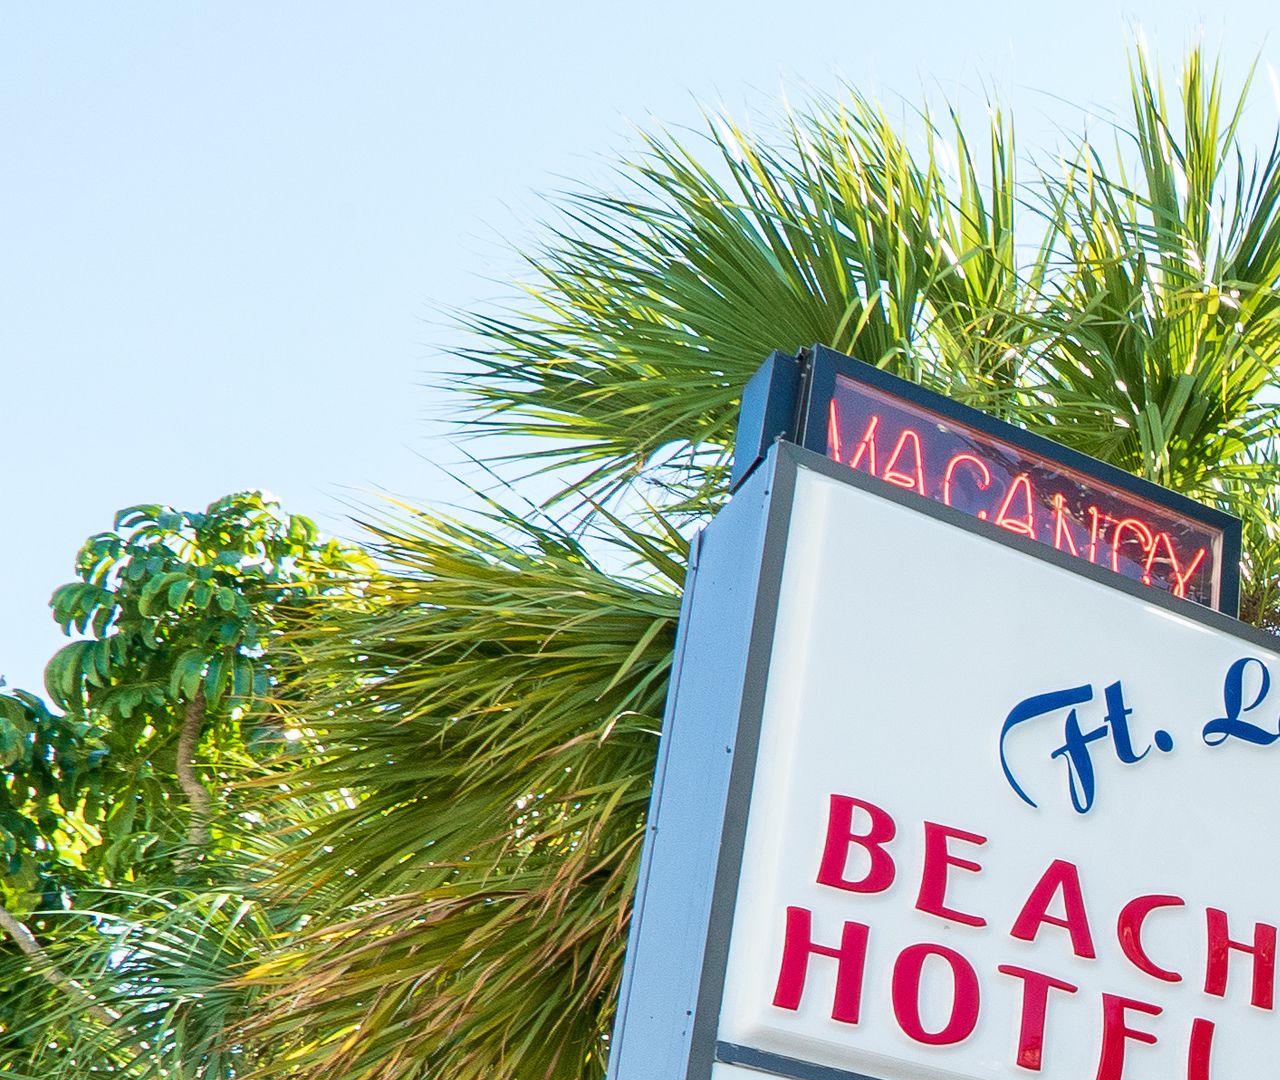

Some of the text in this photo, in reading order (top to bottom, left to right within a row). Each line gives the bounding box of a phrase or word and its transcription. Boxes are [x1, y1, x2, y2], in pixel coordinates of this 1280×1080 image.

[828, 398, 1207, 600] VACANCY
[1000, 680, 1174, 814] Ft.
[815, 793, 1278, 1011] BEACH
